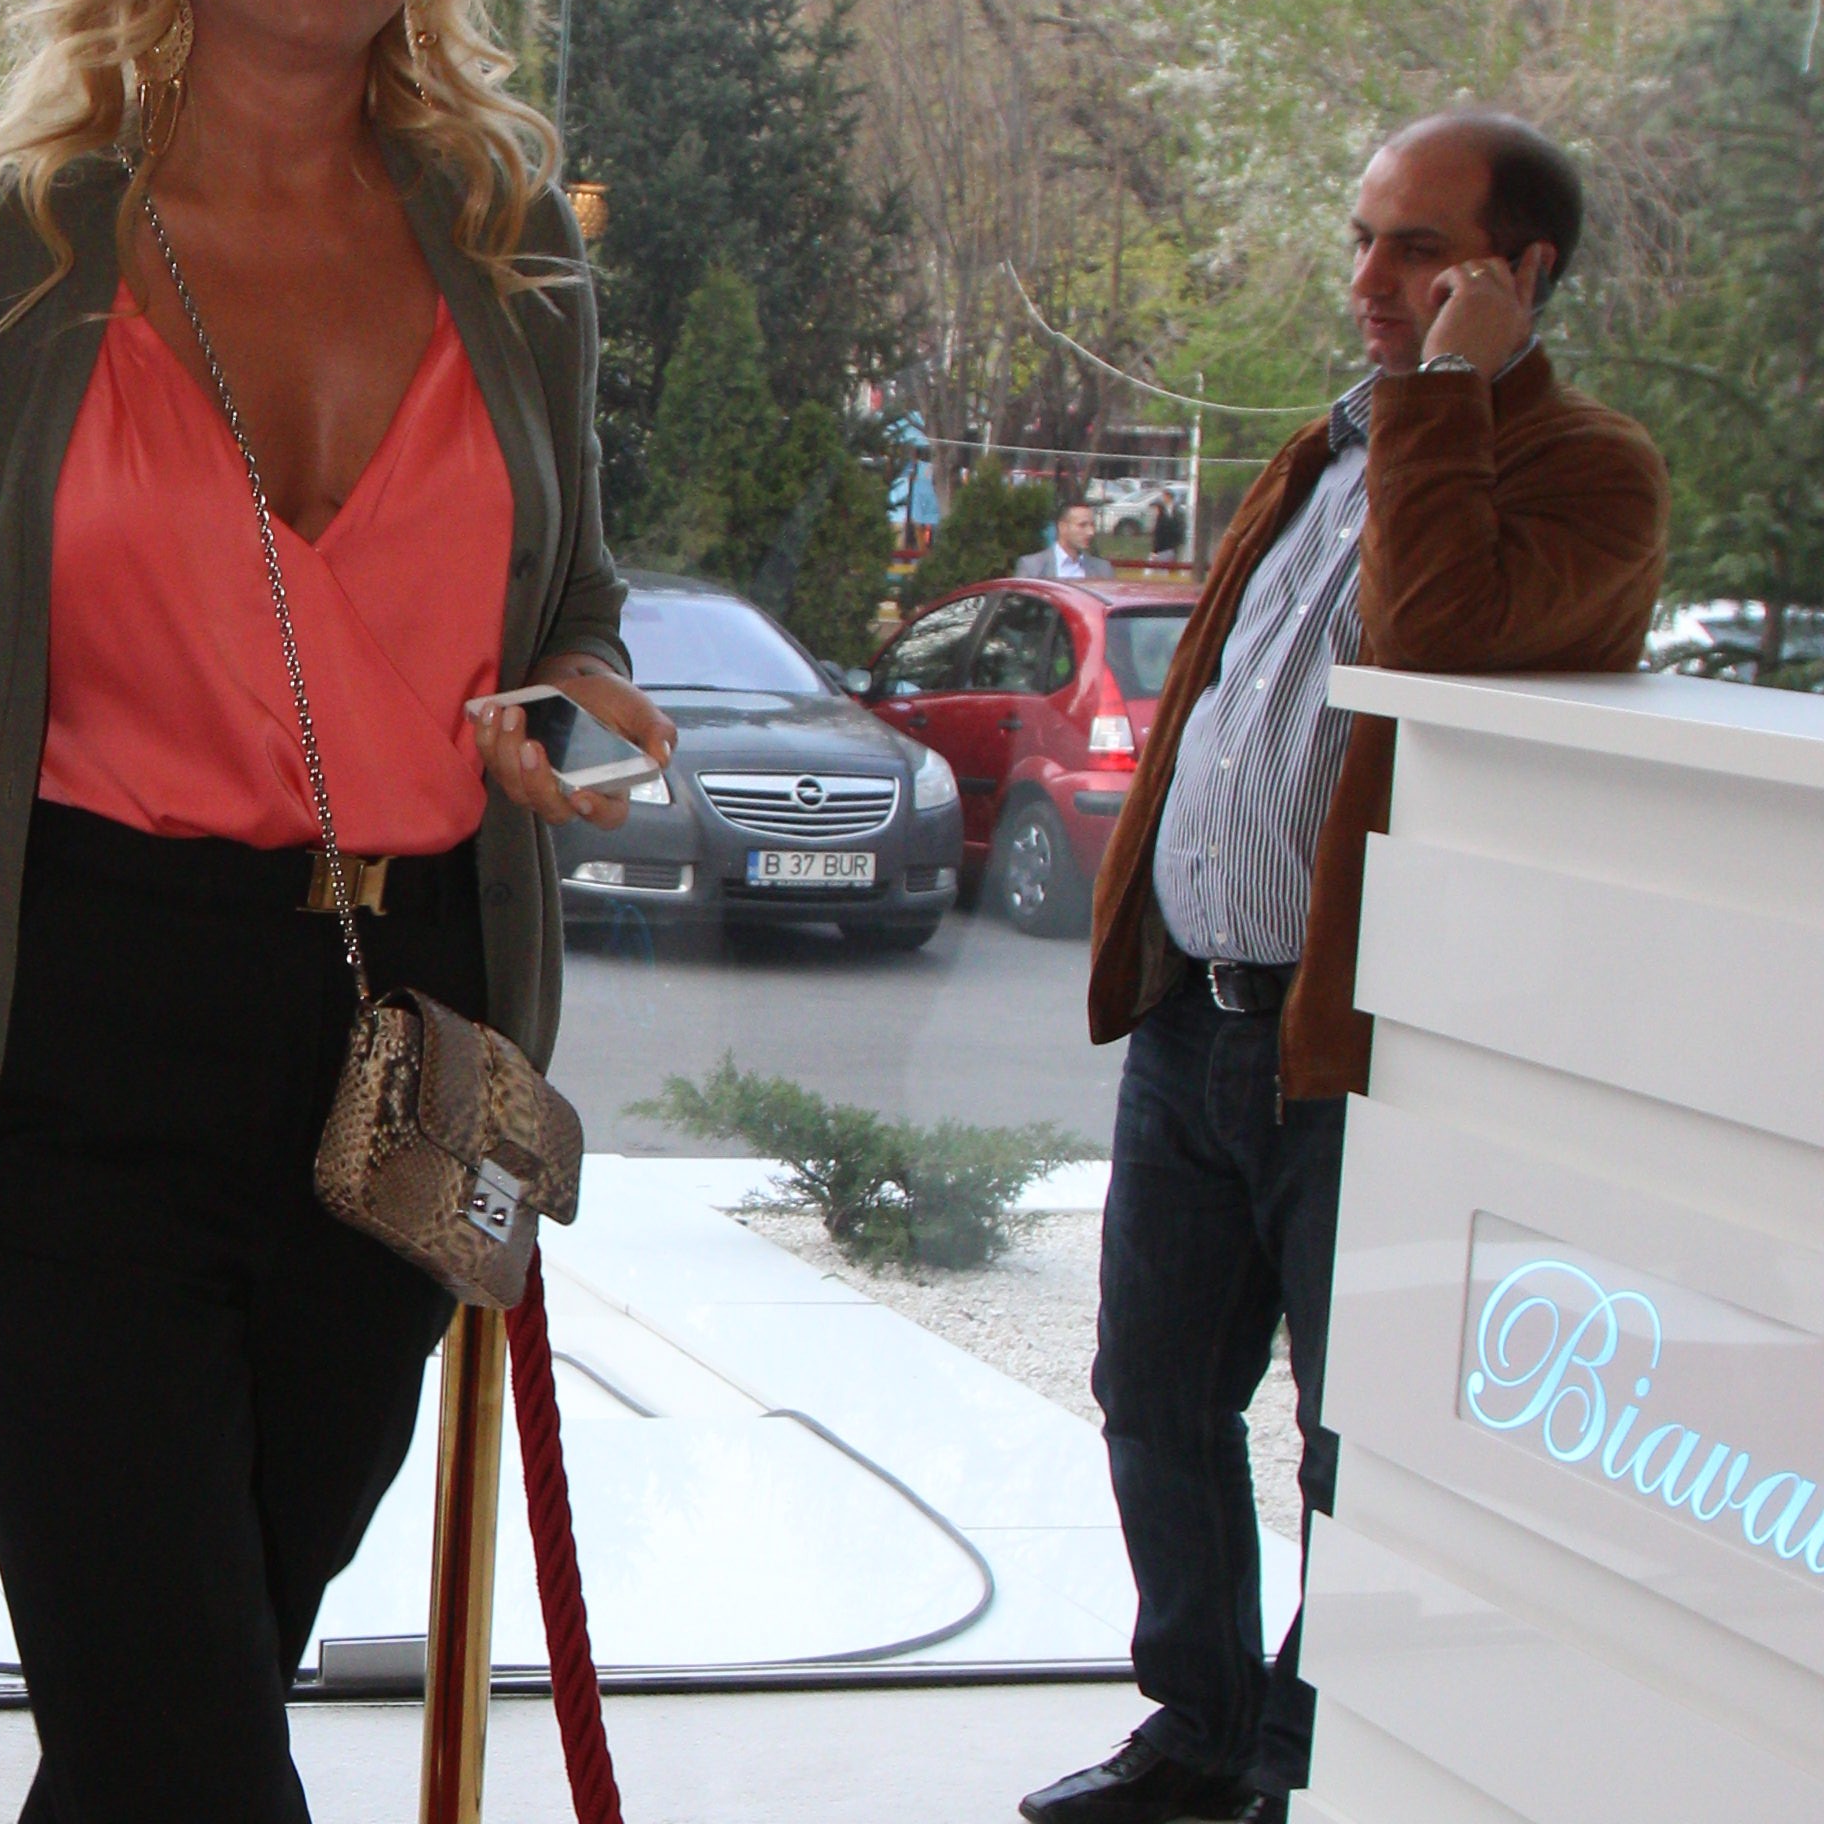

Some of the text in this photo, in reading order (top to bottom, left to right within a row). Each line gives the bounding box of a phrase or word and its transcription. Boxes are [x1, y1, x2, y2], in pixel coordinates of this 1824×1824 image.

[765, 853, 868, 876] B 37 BUR
